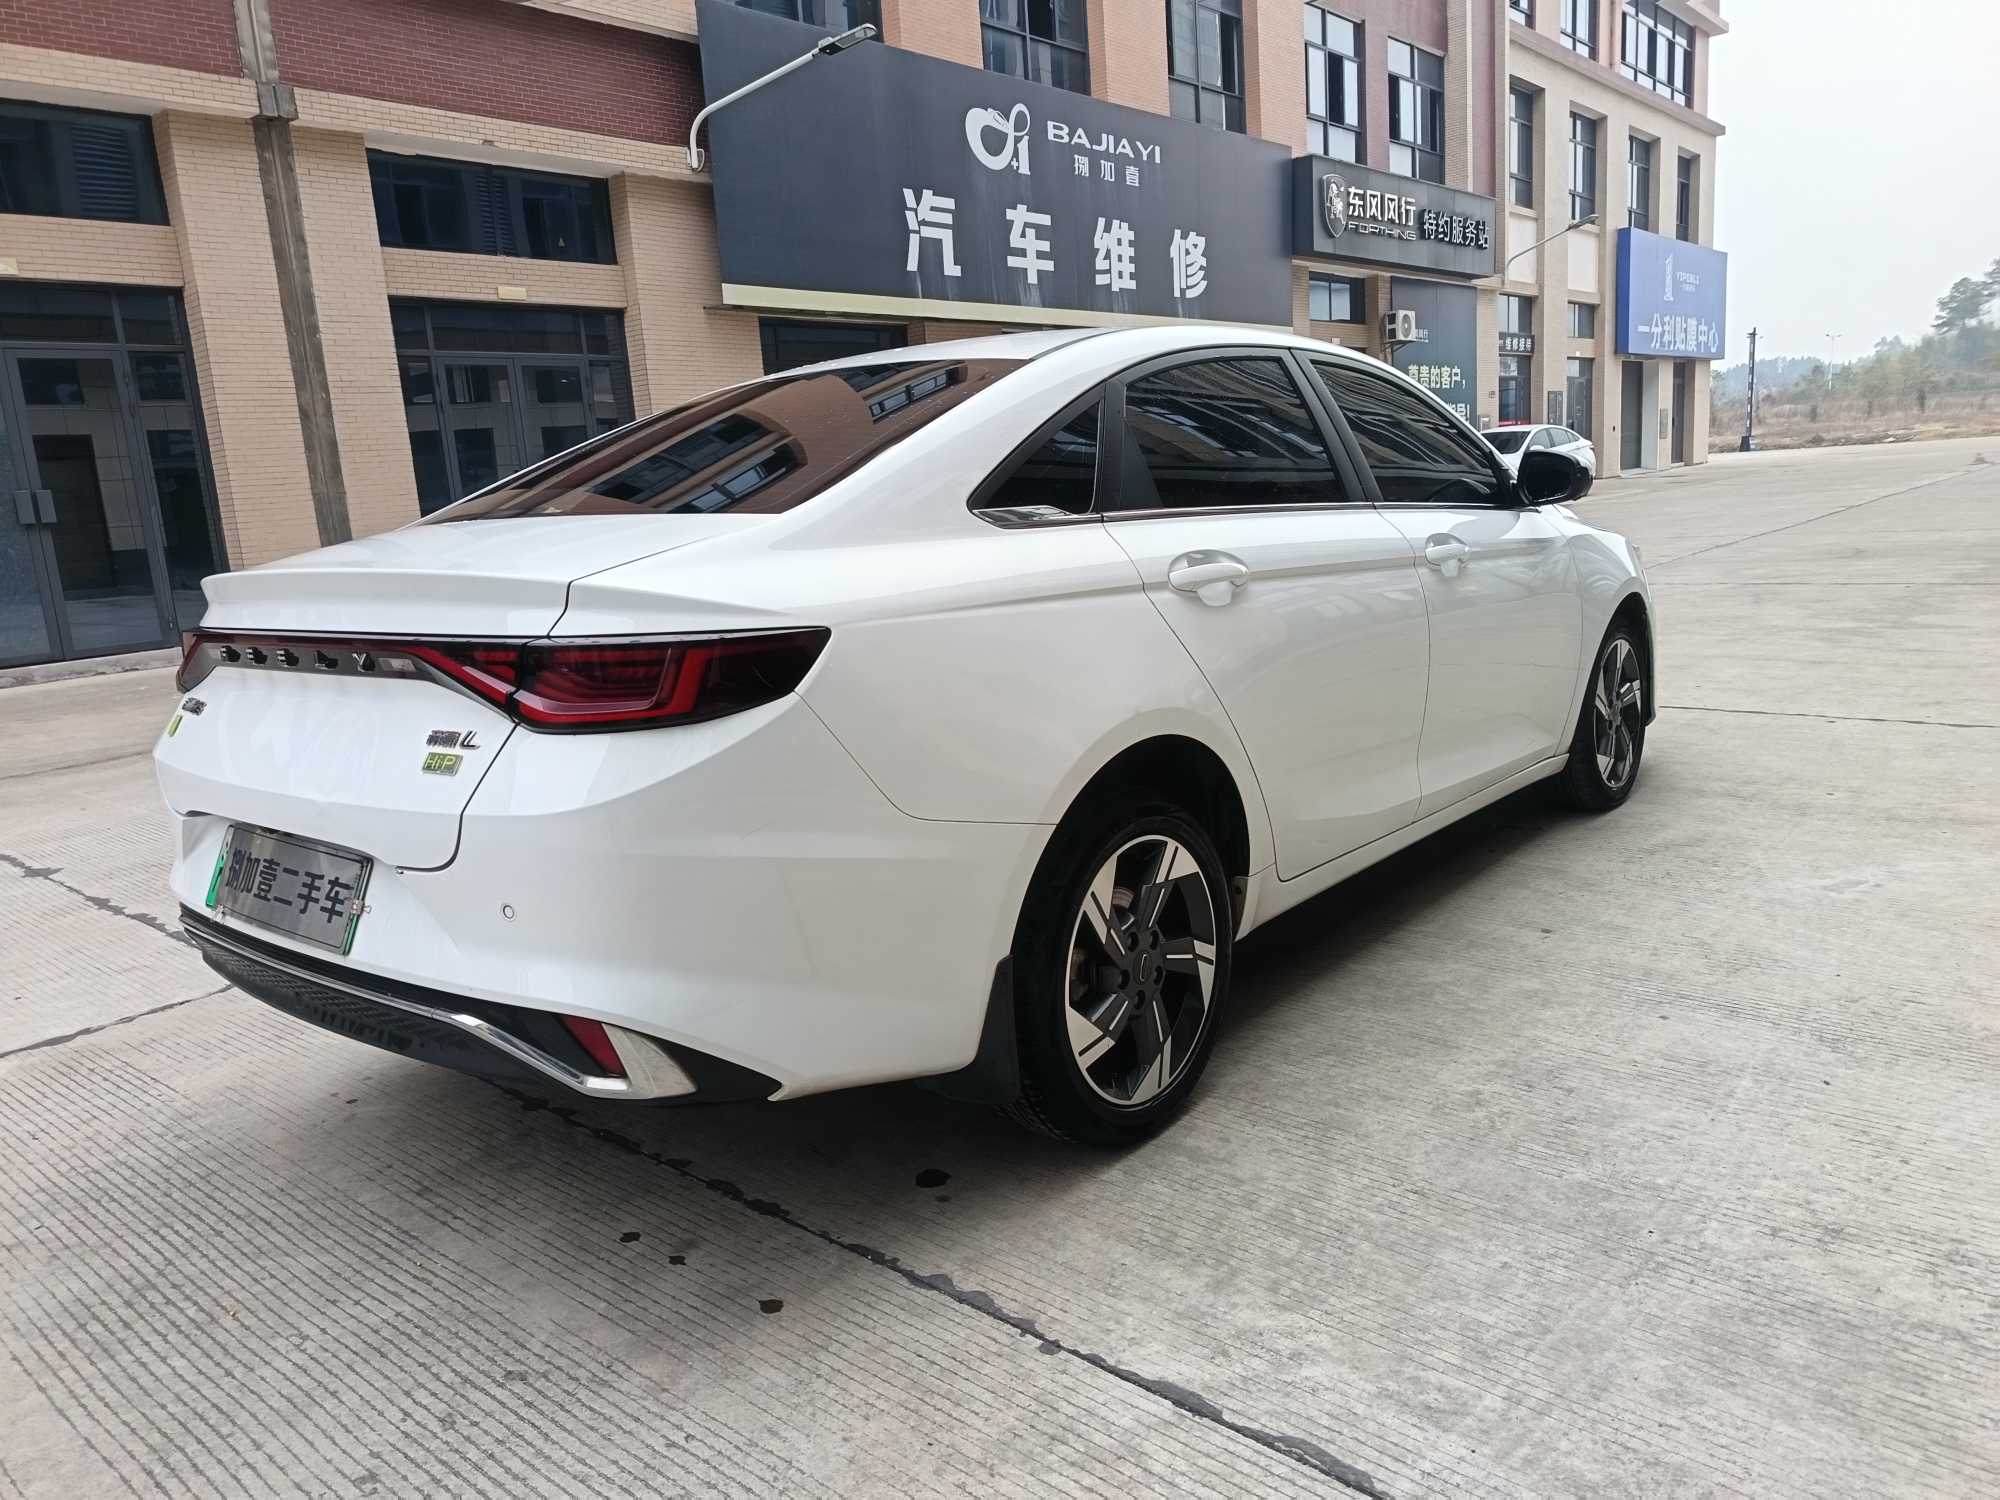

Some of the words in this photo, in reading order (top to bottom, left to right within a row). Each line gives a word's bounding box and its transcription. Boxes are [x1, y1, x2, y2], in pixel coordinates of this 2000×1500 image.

[1047, 120, 1161, 164] BAJIAYI
[1073, 153, 1140, 187] 捌加壹
[1348, 186, 1416, 226] 东风风行
[902, 187, 1208, 298] 汽车维修
[1348, 221, 1417, 241] FORTHING
[1423, 208, 1489, 250] 特约服务站
